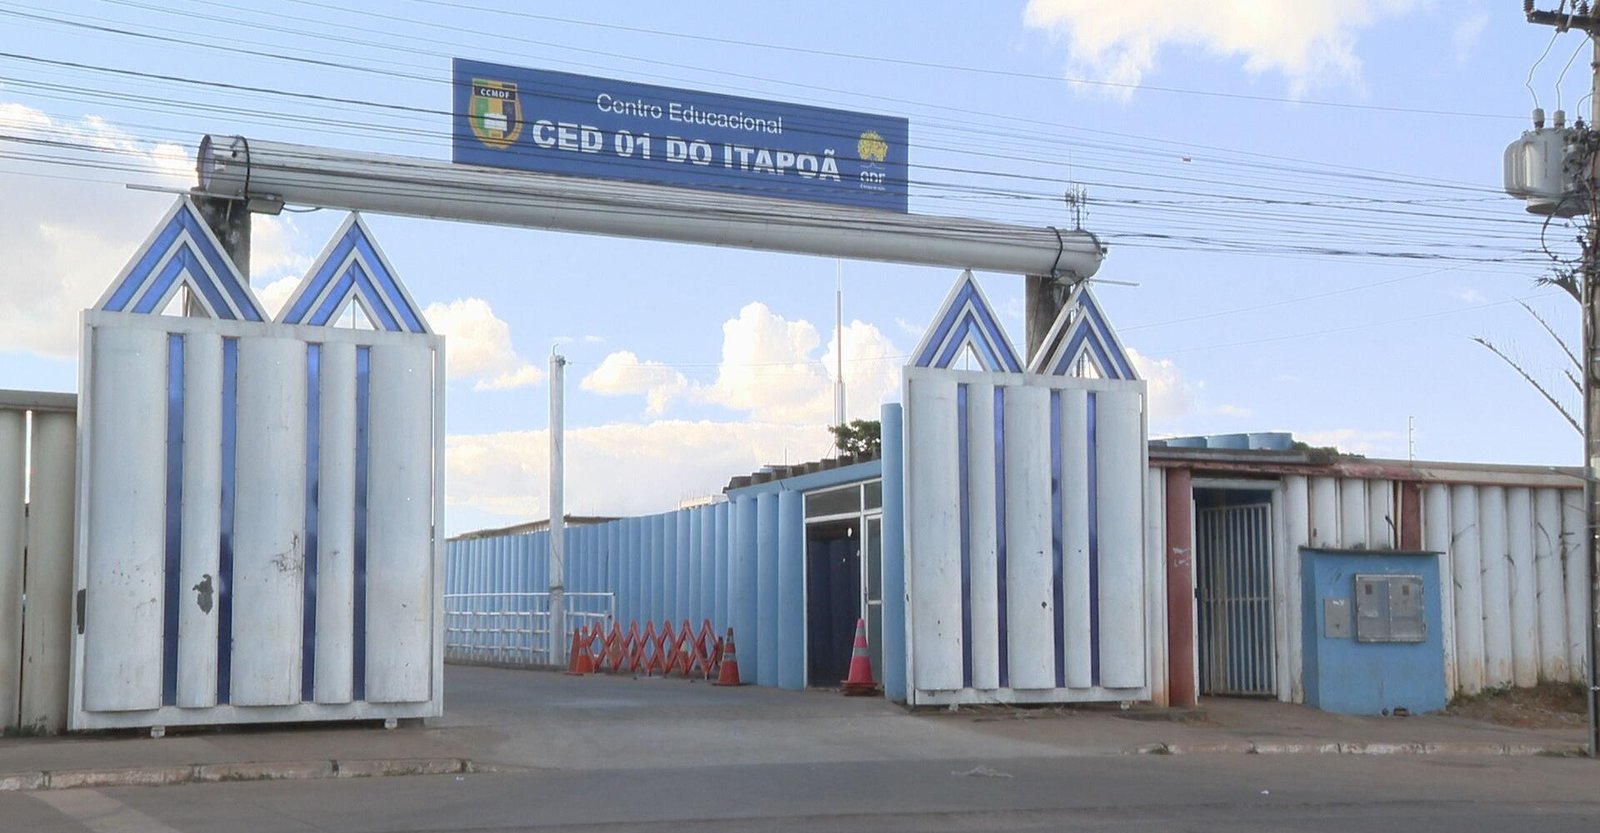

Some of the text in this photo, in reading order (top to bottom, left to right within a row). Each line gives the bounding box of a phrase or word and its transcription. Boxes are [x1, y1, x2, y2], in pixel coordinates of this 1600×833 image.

[480, 88, 510, 99] CCMDF
[669, 102, 783, 135] Educacional
[532, 119, 841, 182] CED 01 DO ITAPOÃ
